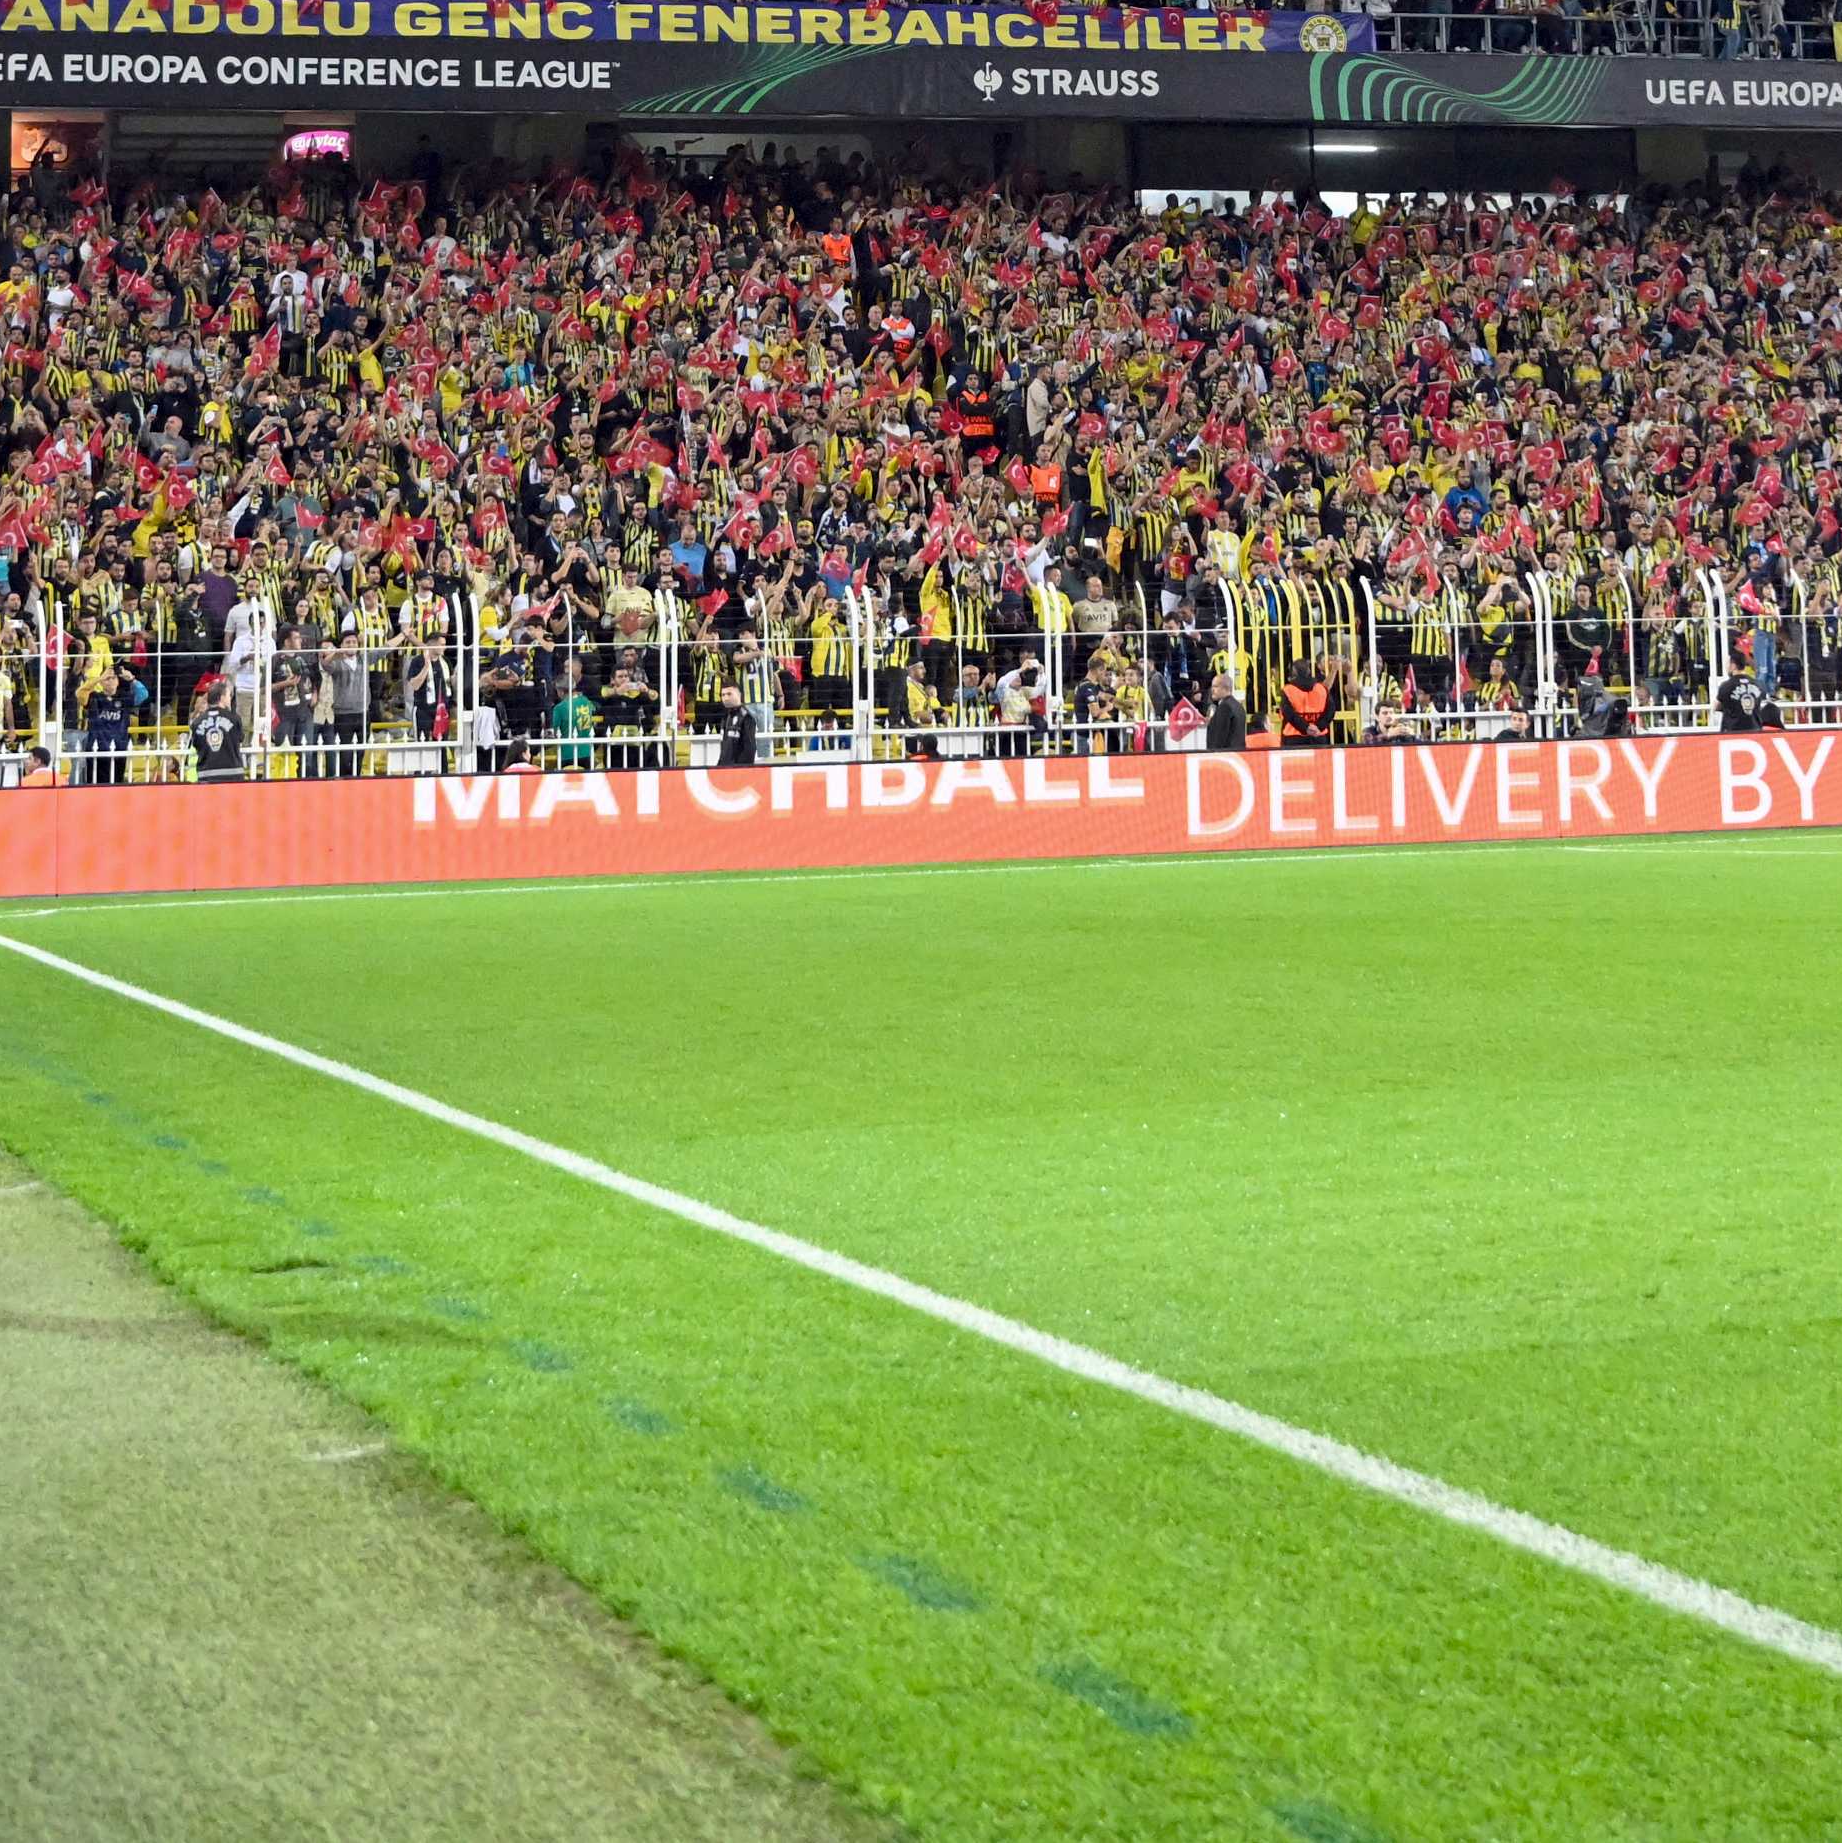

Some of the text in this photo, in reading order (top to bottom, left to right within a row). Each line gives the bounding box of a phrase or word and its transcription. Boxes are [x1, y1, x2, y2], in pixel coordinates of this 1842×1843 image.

[64, 54, 206, 85] EUROPA
[216, 56, 461, 87] CONFERENCE
[1011, 67, 1160, 97] STRAUSS
[1645, 79, 1726, 106] UEFA
[1187, 737, 1678, 836] DELIVERY
[1718, 735, 1836, 825] BY
